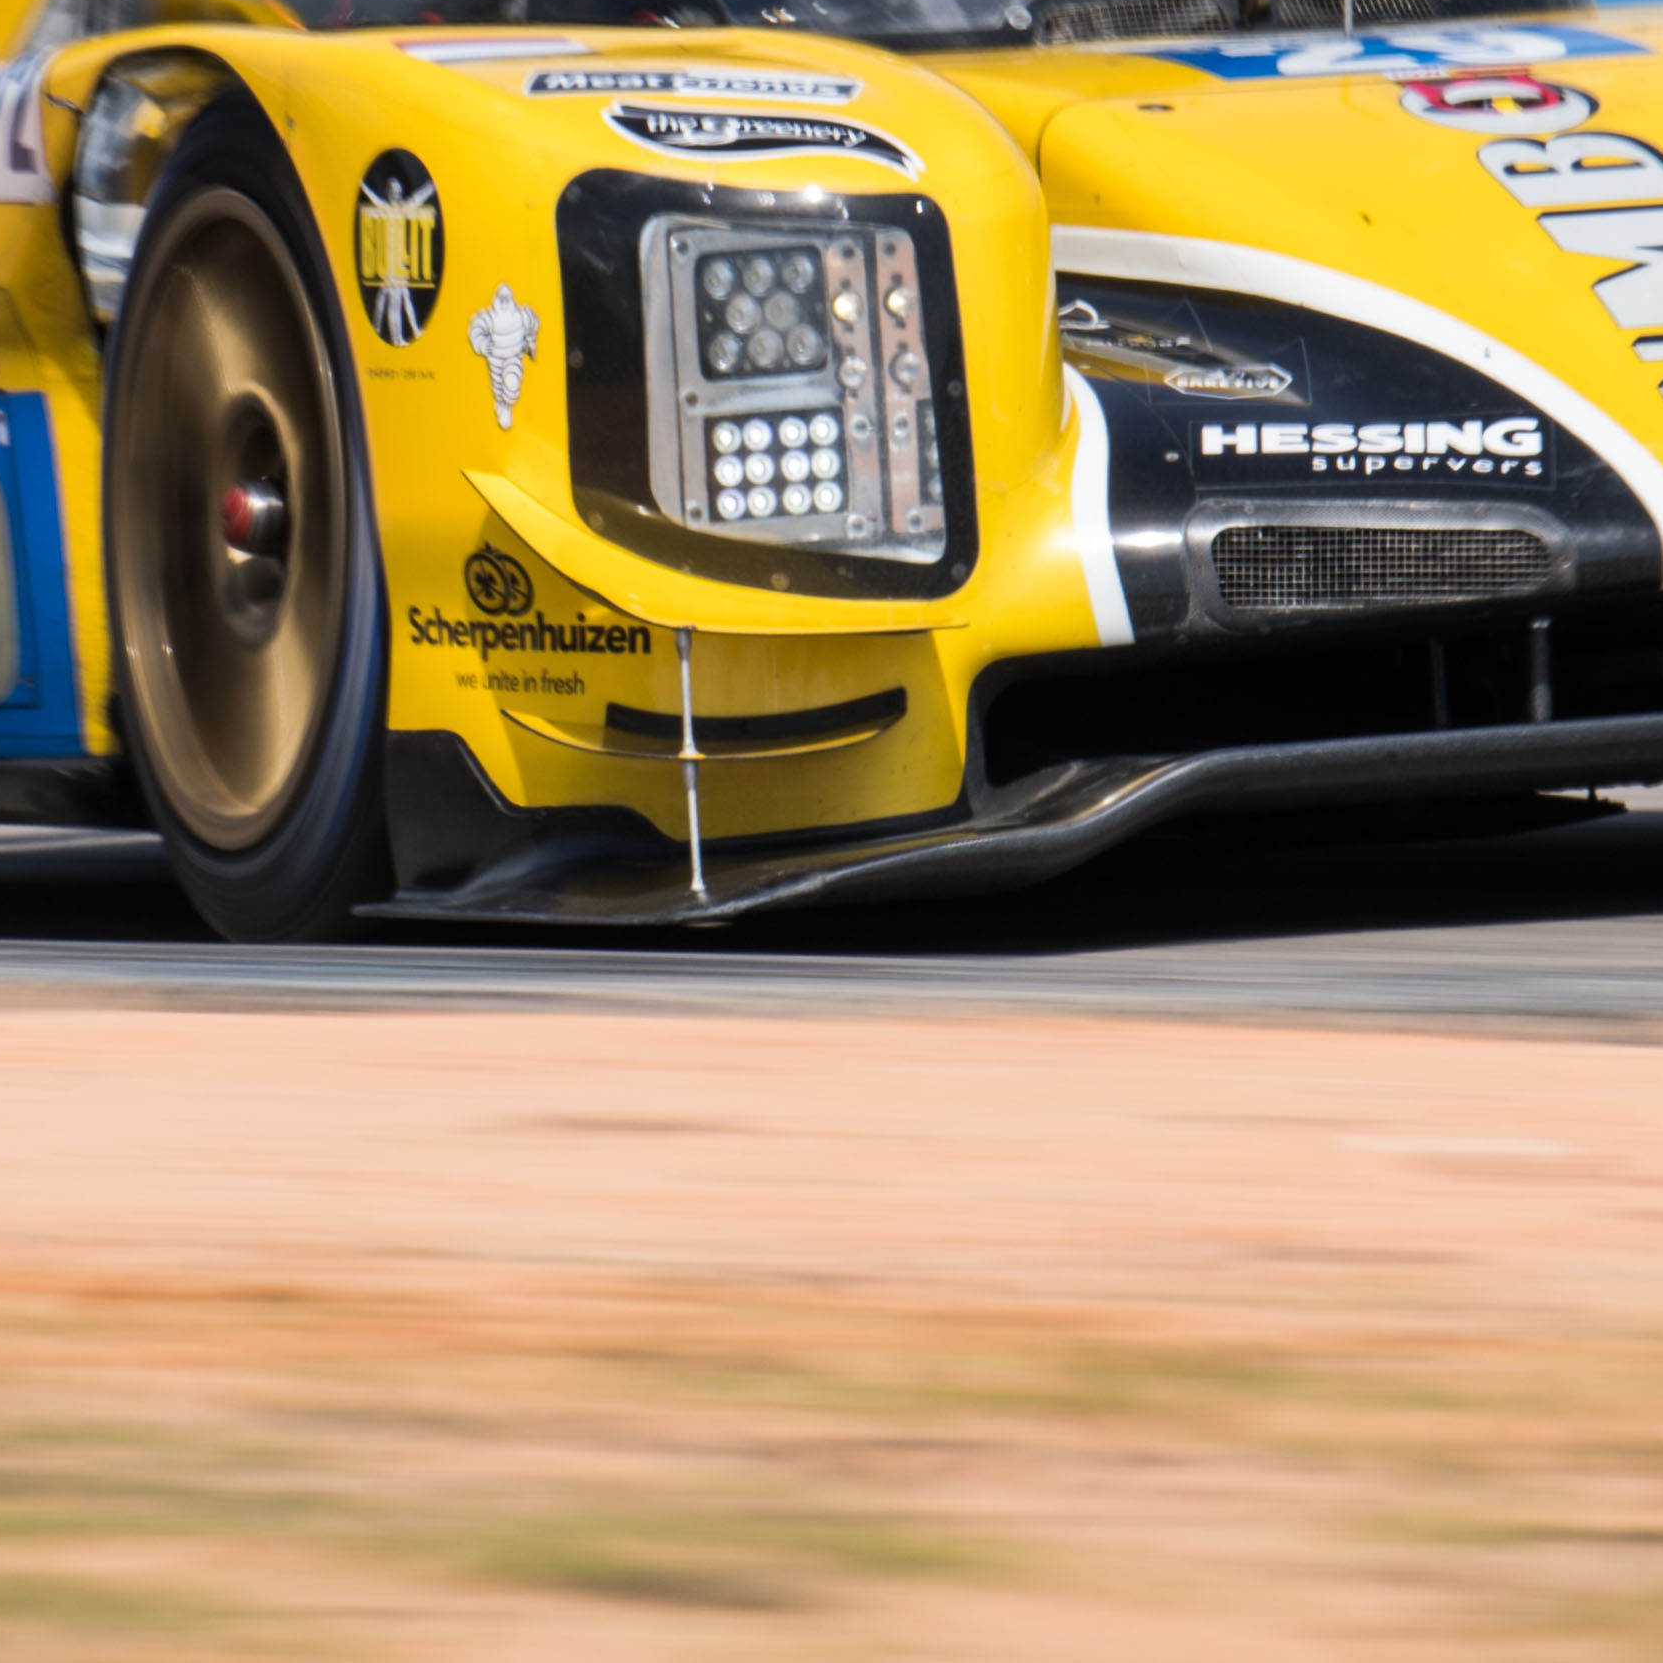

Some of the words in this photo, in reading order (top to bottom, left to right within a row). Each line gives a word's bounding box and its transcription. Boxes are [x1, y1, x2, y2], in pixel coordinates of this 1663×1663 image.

[1200, 416, 1543, 457] HESSING
[1311, 453, 1544, 476] supervers
[408, 603, 653, 662] Scherpenhuizen
[481, 667, 520, 694] unite
[523, 667, 537, 693] in
[540, 666, 585, 696] fresh
